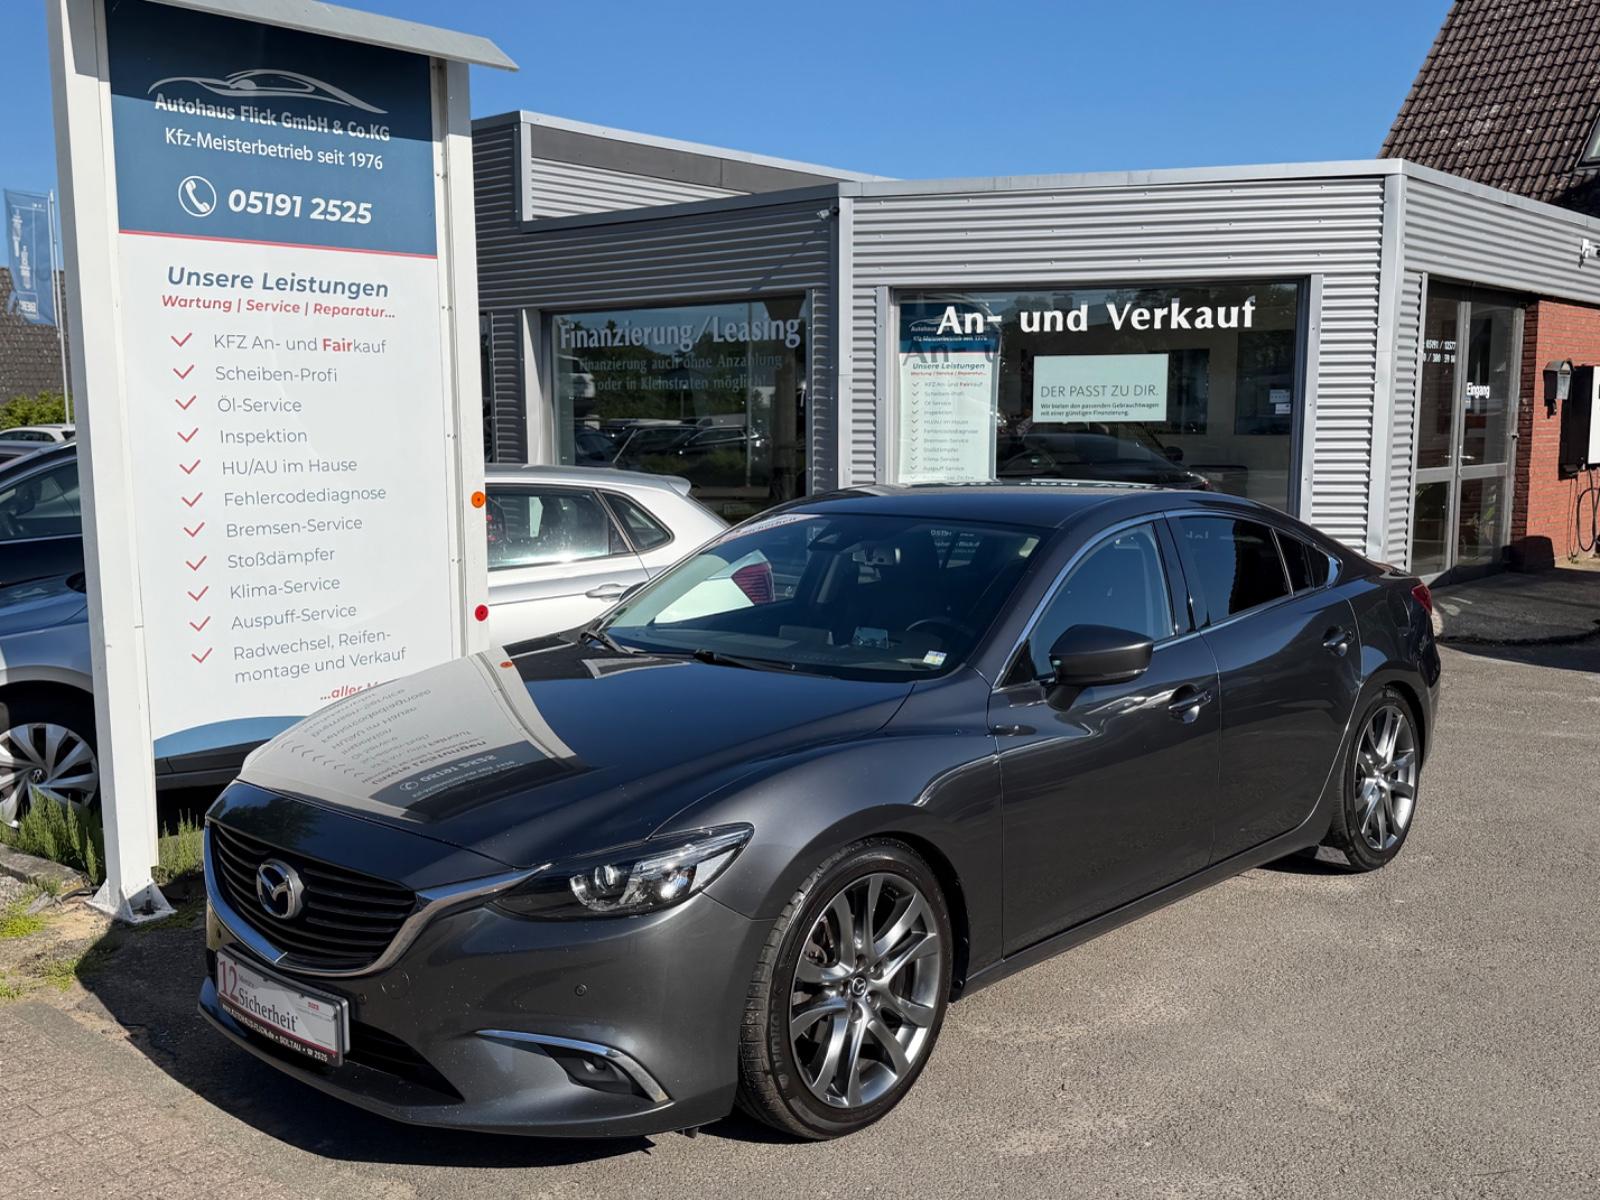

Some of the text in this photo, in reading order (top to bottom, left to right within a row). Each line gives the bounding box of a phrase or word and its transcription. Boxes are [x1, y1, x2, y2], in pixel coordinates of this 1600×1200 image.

[155, 93, 391, 142] Autohaus Flick GmbH & Co.KG
[166, 127, 383, 170] Kfz-Meisterbetrieb seit 1976
[228, 188, 372, 224] 05191 2525
[167, 266, 389, 300] Unsere Leistungen
[162, 295, 232, 312] Wartung
[246, 299, 300, 314] Service
[313, 303, 395, 319] Reparatur...
[936, 295, 1256, 335] An- und Verkauf
[214, 334, 386, 354] KFZ An- und Fairkauf
[559, 315, 801, 352] Finanzierung/Leasing
[579, 352, 783, 374] Finanzierung auch ohne Anzahlung
[215, 366, 338, 383] Scheiben-Profi
[597, 375, 622, 391] oder
[626, 376, 637, 391] in
[1040, 384, 1159, 398] DER PASST ZU DIR.
[1466, 382, 1490, 399] Eingang
[217, 395, 302, 413] Öl-Service
[220, 429, 308, 446] Inspektion
[222, 458, 358, 476] HU/AU im Hause
[224, 487, 386, 507] Fehlercodediagnose
[226, 517, 363, 538] Bremsen-Service
[228, 548, 335, 569] Stoßdämpfer
[230, 577, 340, 598] Klima-Service
[232, 604, 357, 629] Auspuff-Service
[234, 629, 391, 660] Radwechsel, Reifen-
[235, 648, 406, 685] montage und Verkauf
[220, 960, 240, 1004] 12
[238, 988, 297, 1032] Sicherheit
